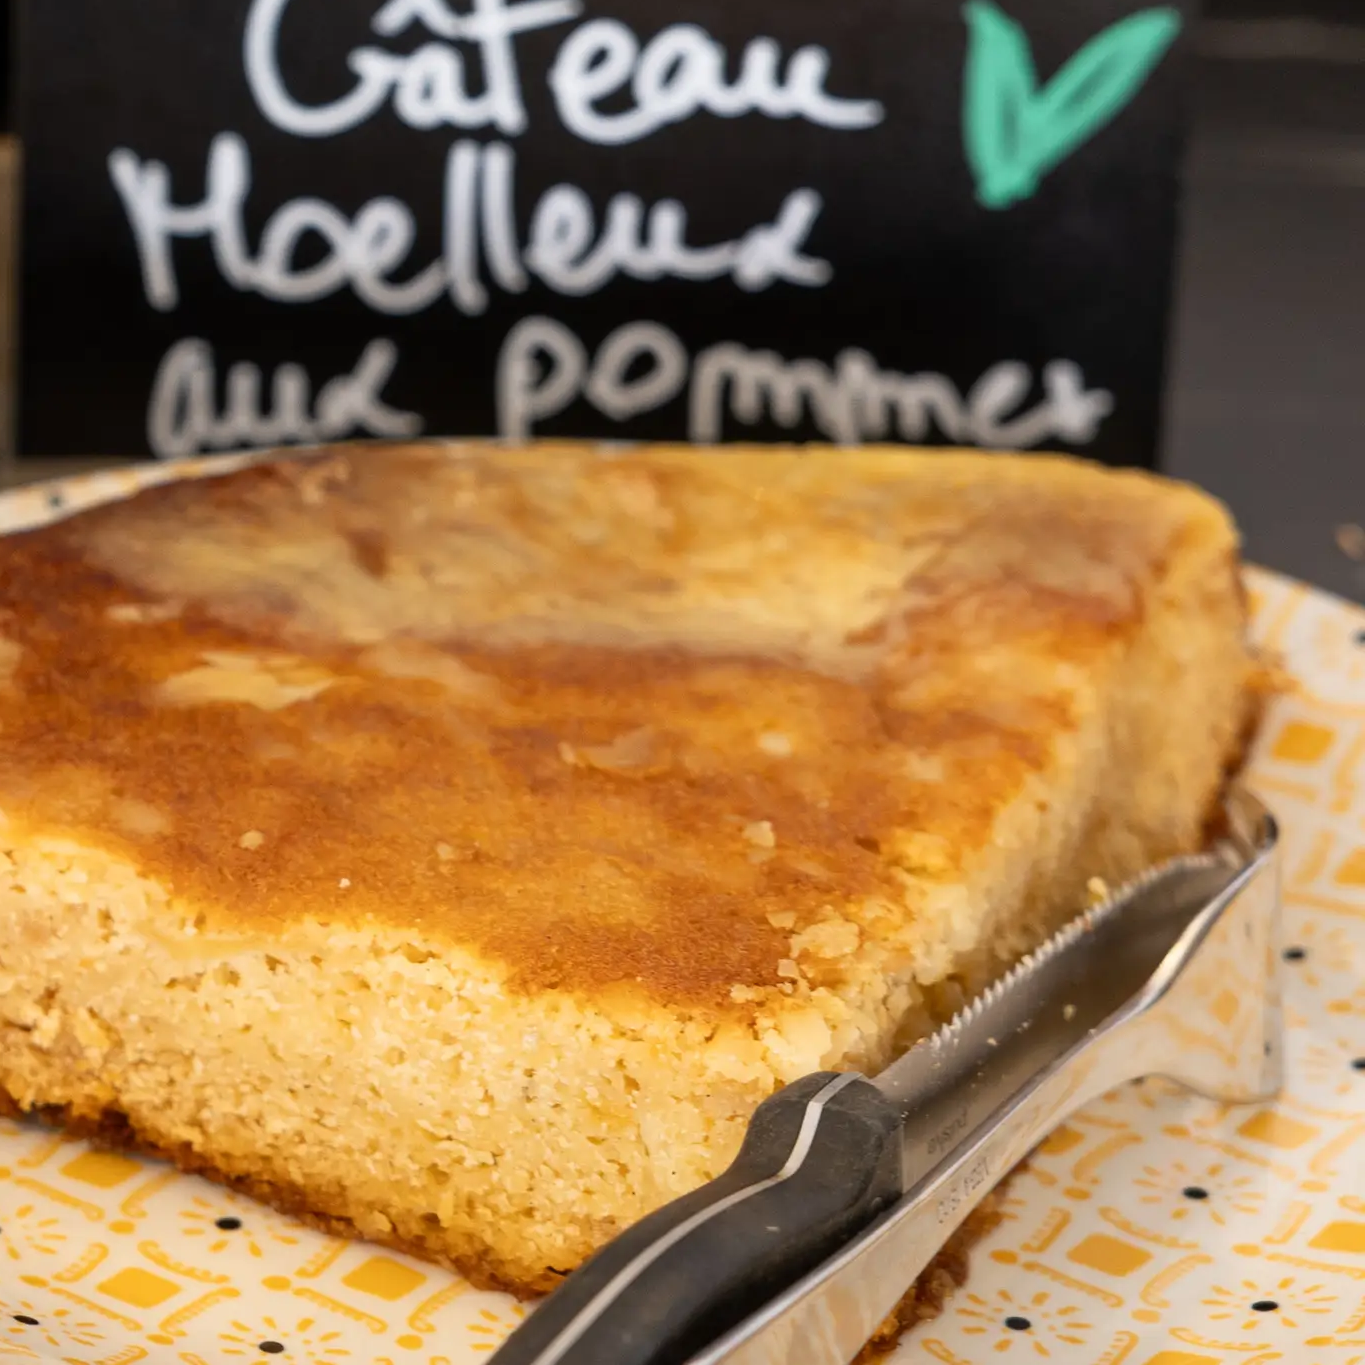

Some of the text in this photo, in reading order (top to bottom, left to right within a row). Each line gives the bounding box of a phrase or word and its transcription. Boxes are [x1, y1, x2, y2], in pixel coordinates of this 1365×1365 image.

[106, 129, 835, 314] Moelleux
[145, 316, 1115, 454] aux pommes
